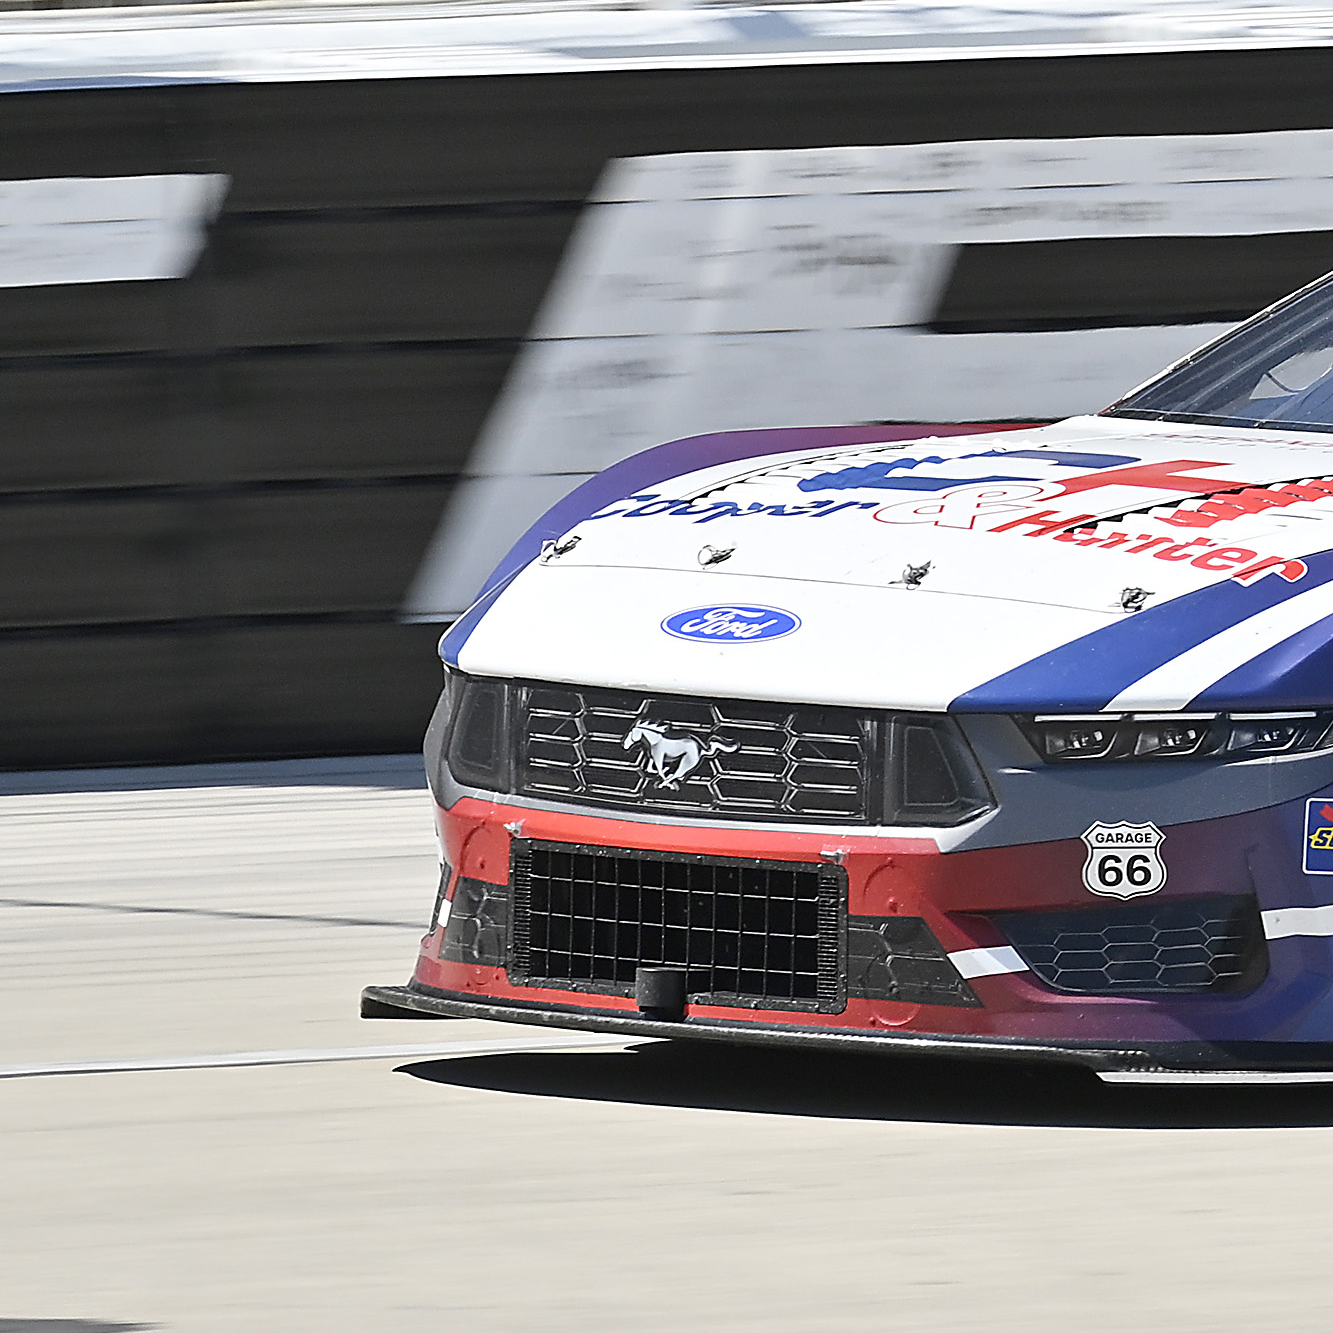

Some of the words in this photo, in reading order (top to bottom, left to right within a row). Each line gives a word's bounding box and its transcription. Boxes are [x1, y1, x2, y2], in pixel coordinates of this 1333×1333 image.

[676, 607, 782, 639] Ford
[1095, 832, 1153, 844] GARAGE
[1099, 854, 1151, 887] 66
